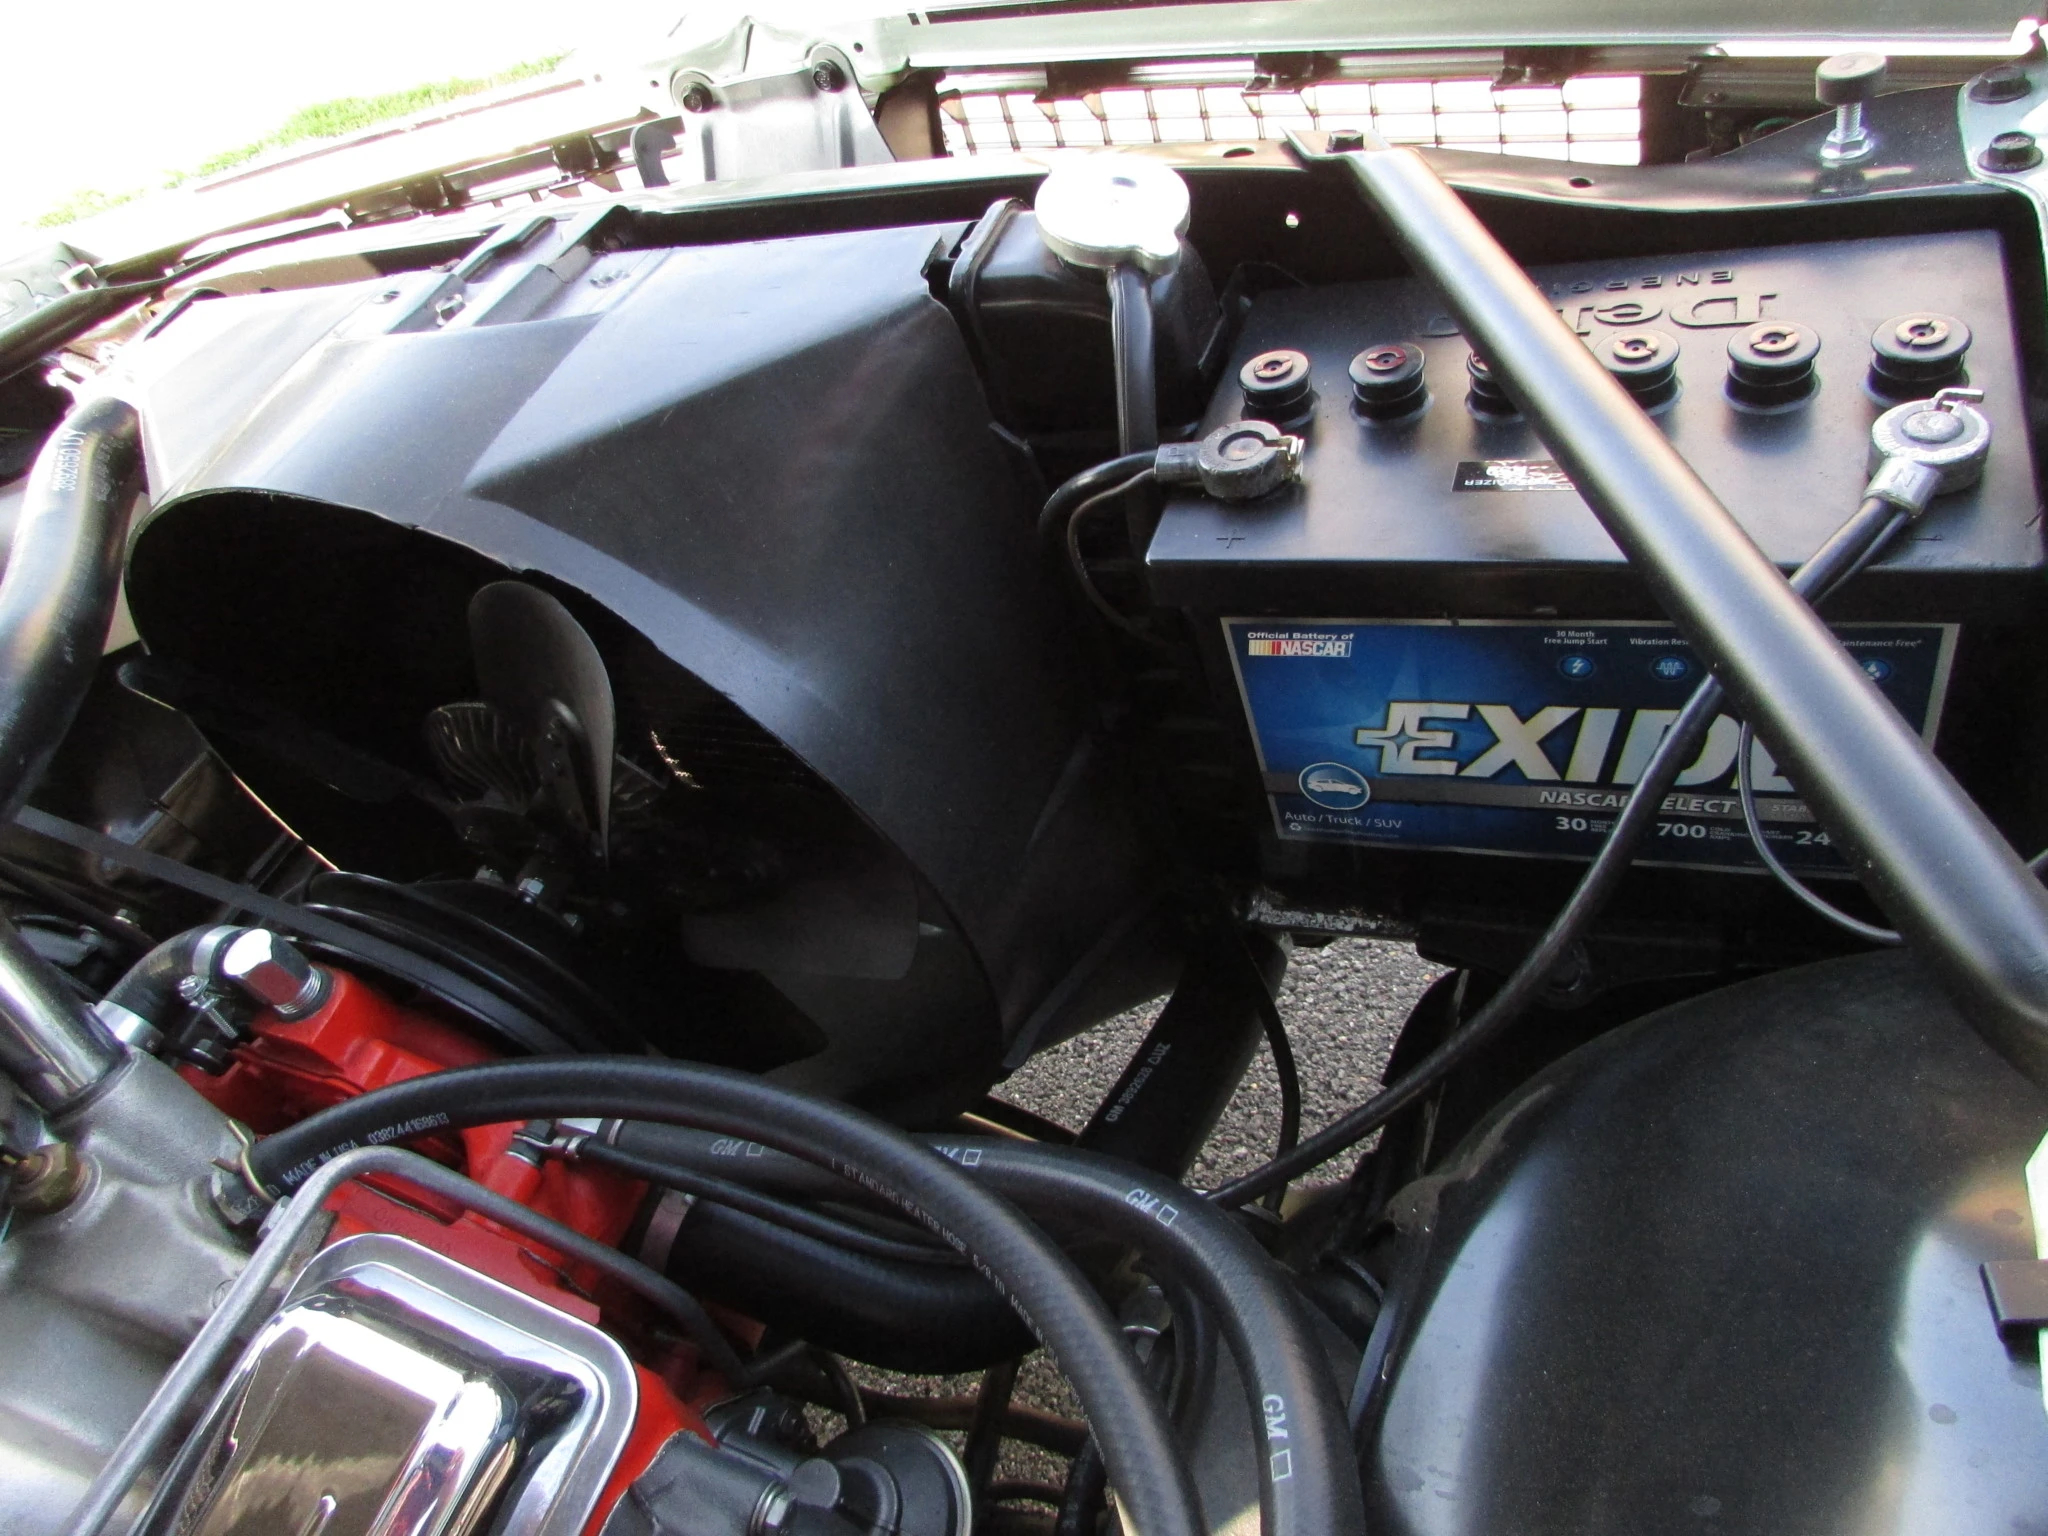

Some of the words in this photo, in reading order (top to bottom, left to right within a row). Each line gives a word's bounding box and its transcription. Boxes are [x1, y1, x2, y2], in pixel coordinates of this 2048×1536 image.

[1293, 633, 1338, 641] Battery
[1563, 638, 1585, 646] Jump
[1281, 640, 1346, 656] NASCAR
[1356, 702, 1795, 793] EXID
[1660, 797, 1737, 814] ELECT
[1285, 811, 1316, 822] Auto
[1325, 814, 1361, 826] Truck
[1374, 818, 1402, 829] SUV
[1555, 816, 1587, 831] 30
[1656, 823, 1706, 838] 700
[1795, 831, 1831, 845] 24
[1125, 1188, 1160, 1213] GM
[1262, 1393, 1288, 1440] GM
